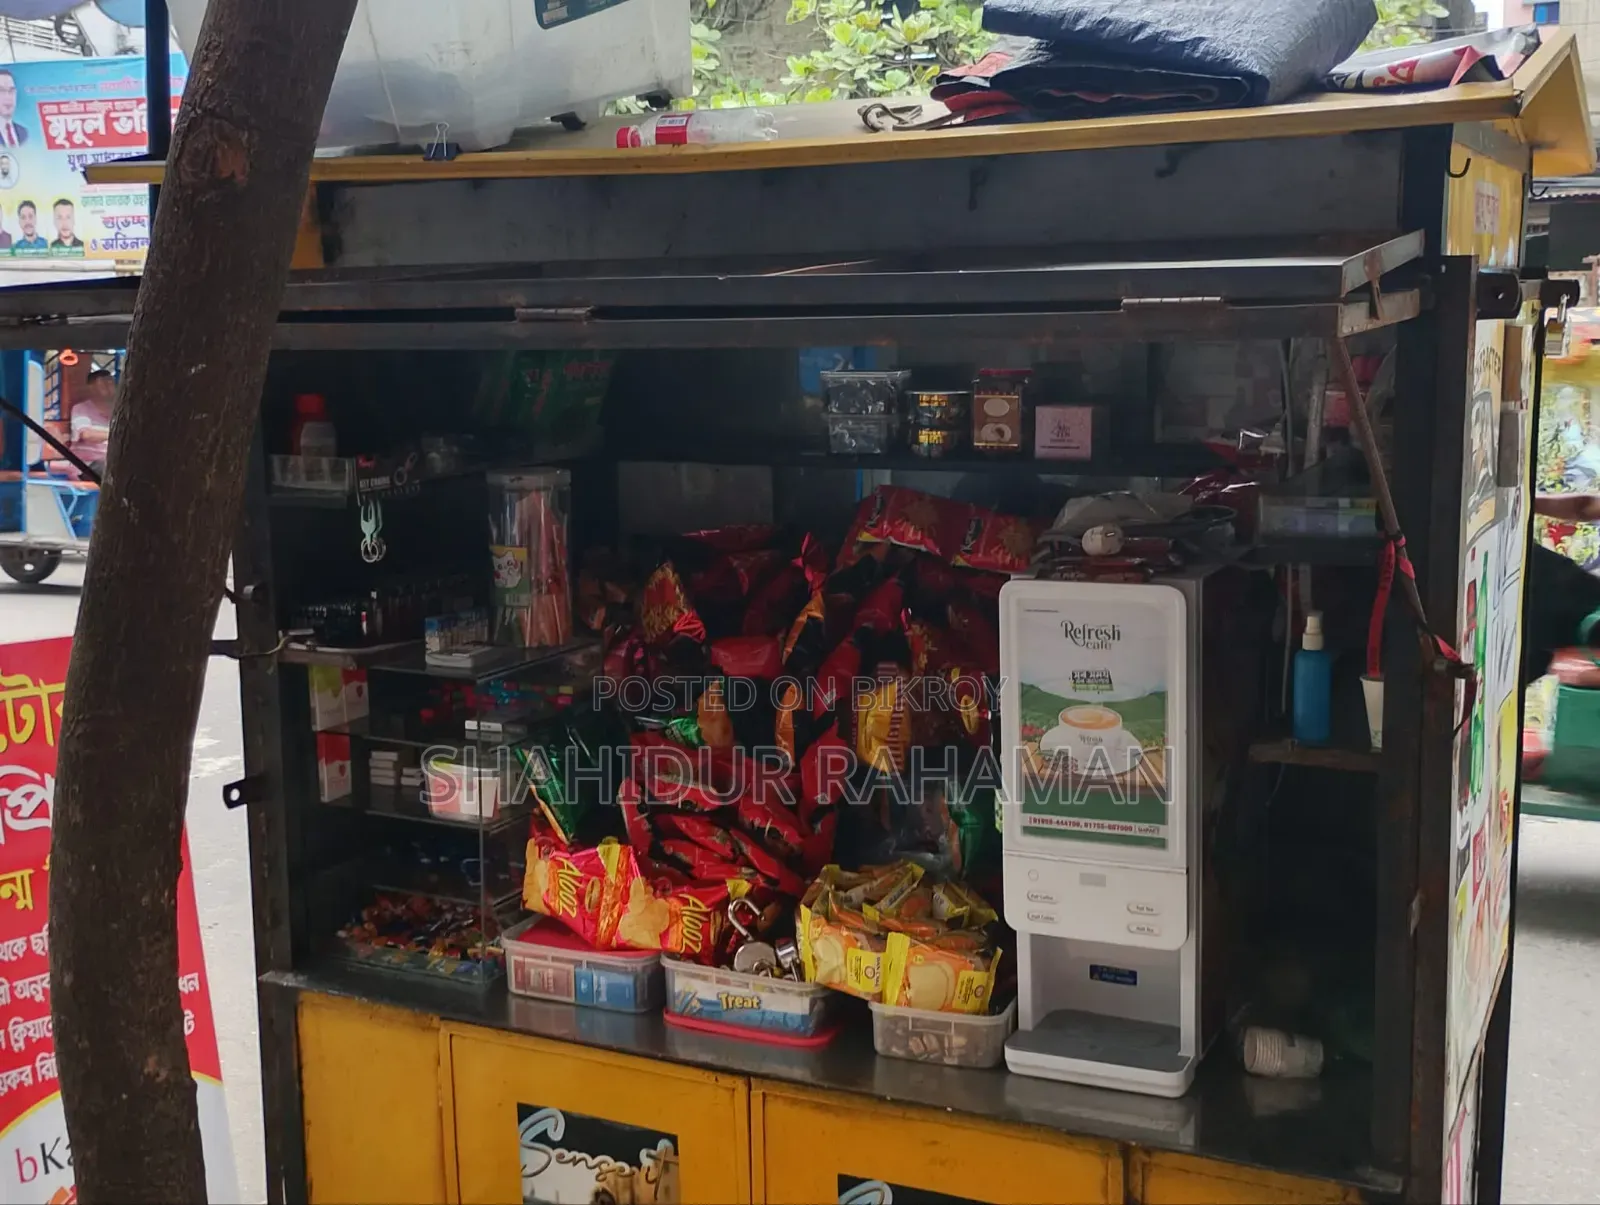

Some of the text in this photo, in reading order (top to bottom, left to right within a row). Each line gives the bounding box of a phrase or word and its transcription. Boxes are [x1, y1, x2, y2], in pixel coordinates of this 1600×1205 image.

[46, 113, 106, 148] মৃদুল
[1060, 619, 1121, 647] Refresh
[556, 857, 585, 919] Alooz
[679, 893, 711, 954] Alooz
[718, 992, 763, 1011] Treat
